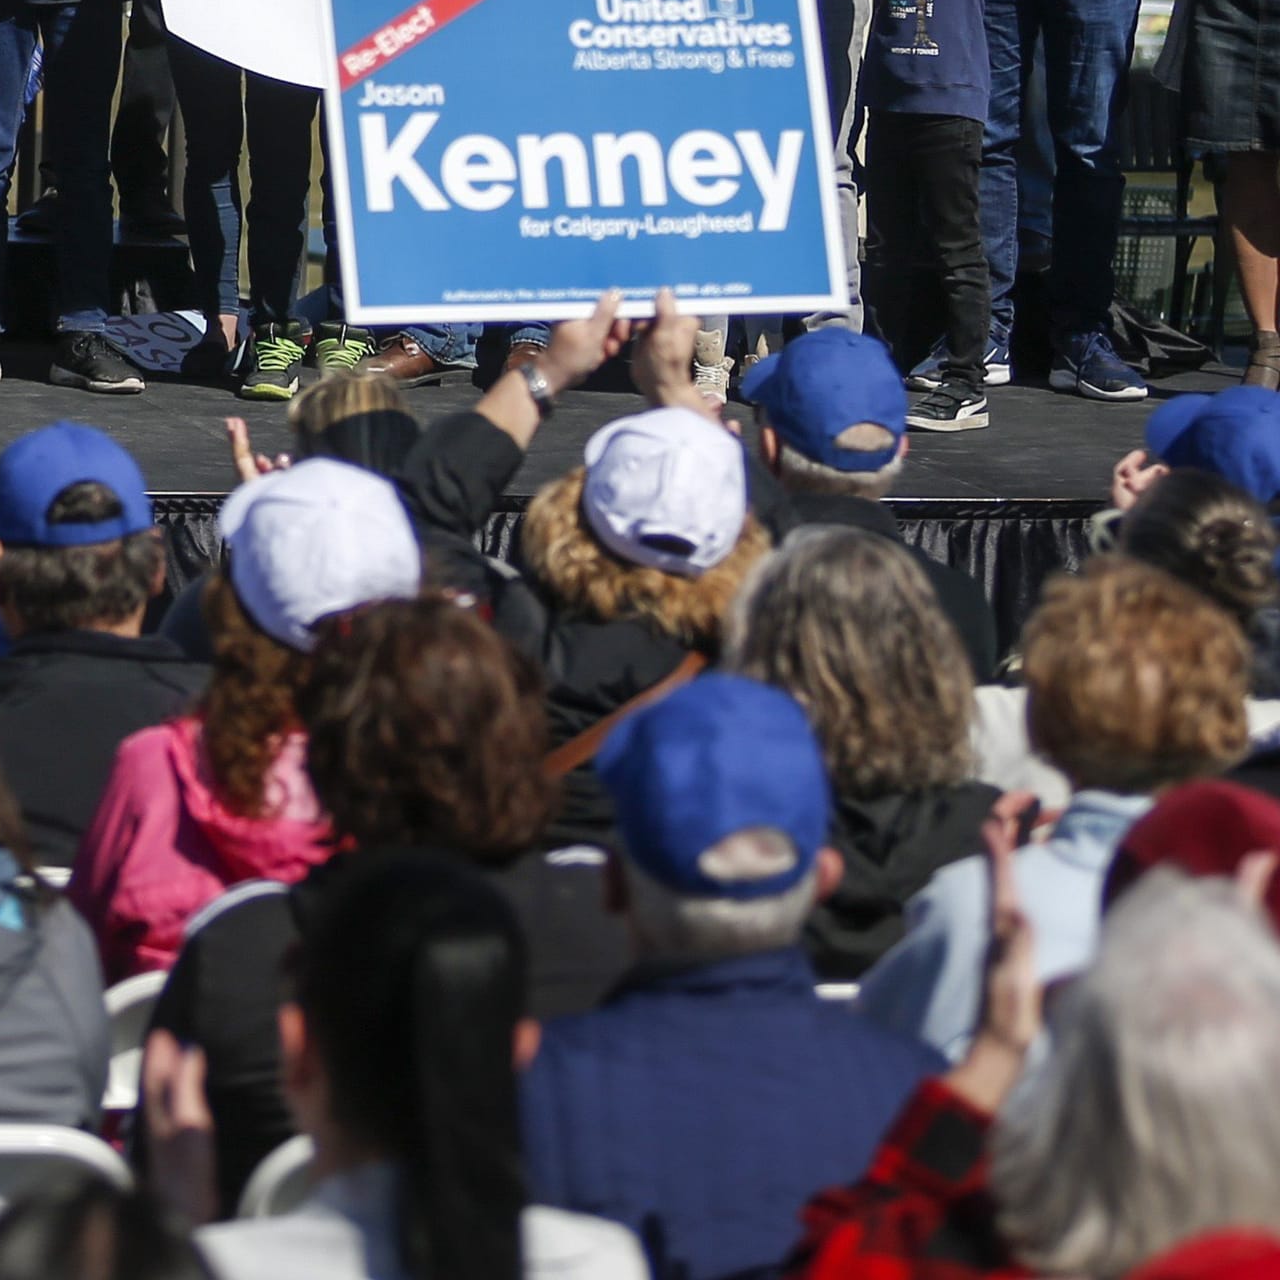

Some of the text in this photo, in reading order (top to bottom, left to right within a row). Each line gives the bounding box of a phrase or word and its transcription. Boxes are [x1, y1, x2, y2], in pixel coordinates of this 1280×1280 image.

[342, 5, 436, 78] Re-Elect
[569, 20, 792, 50] Conservatives
[573, 49, 795, 75] Alberta Strong & Free
[358, 81, 445, 108] Jason
[357, 112, 805, 233] Kenney
[520, 211, 754, 240] for Calgary-Lougheed
